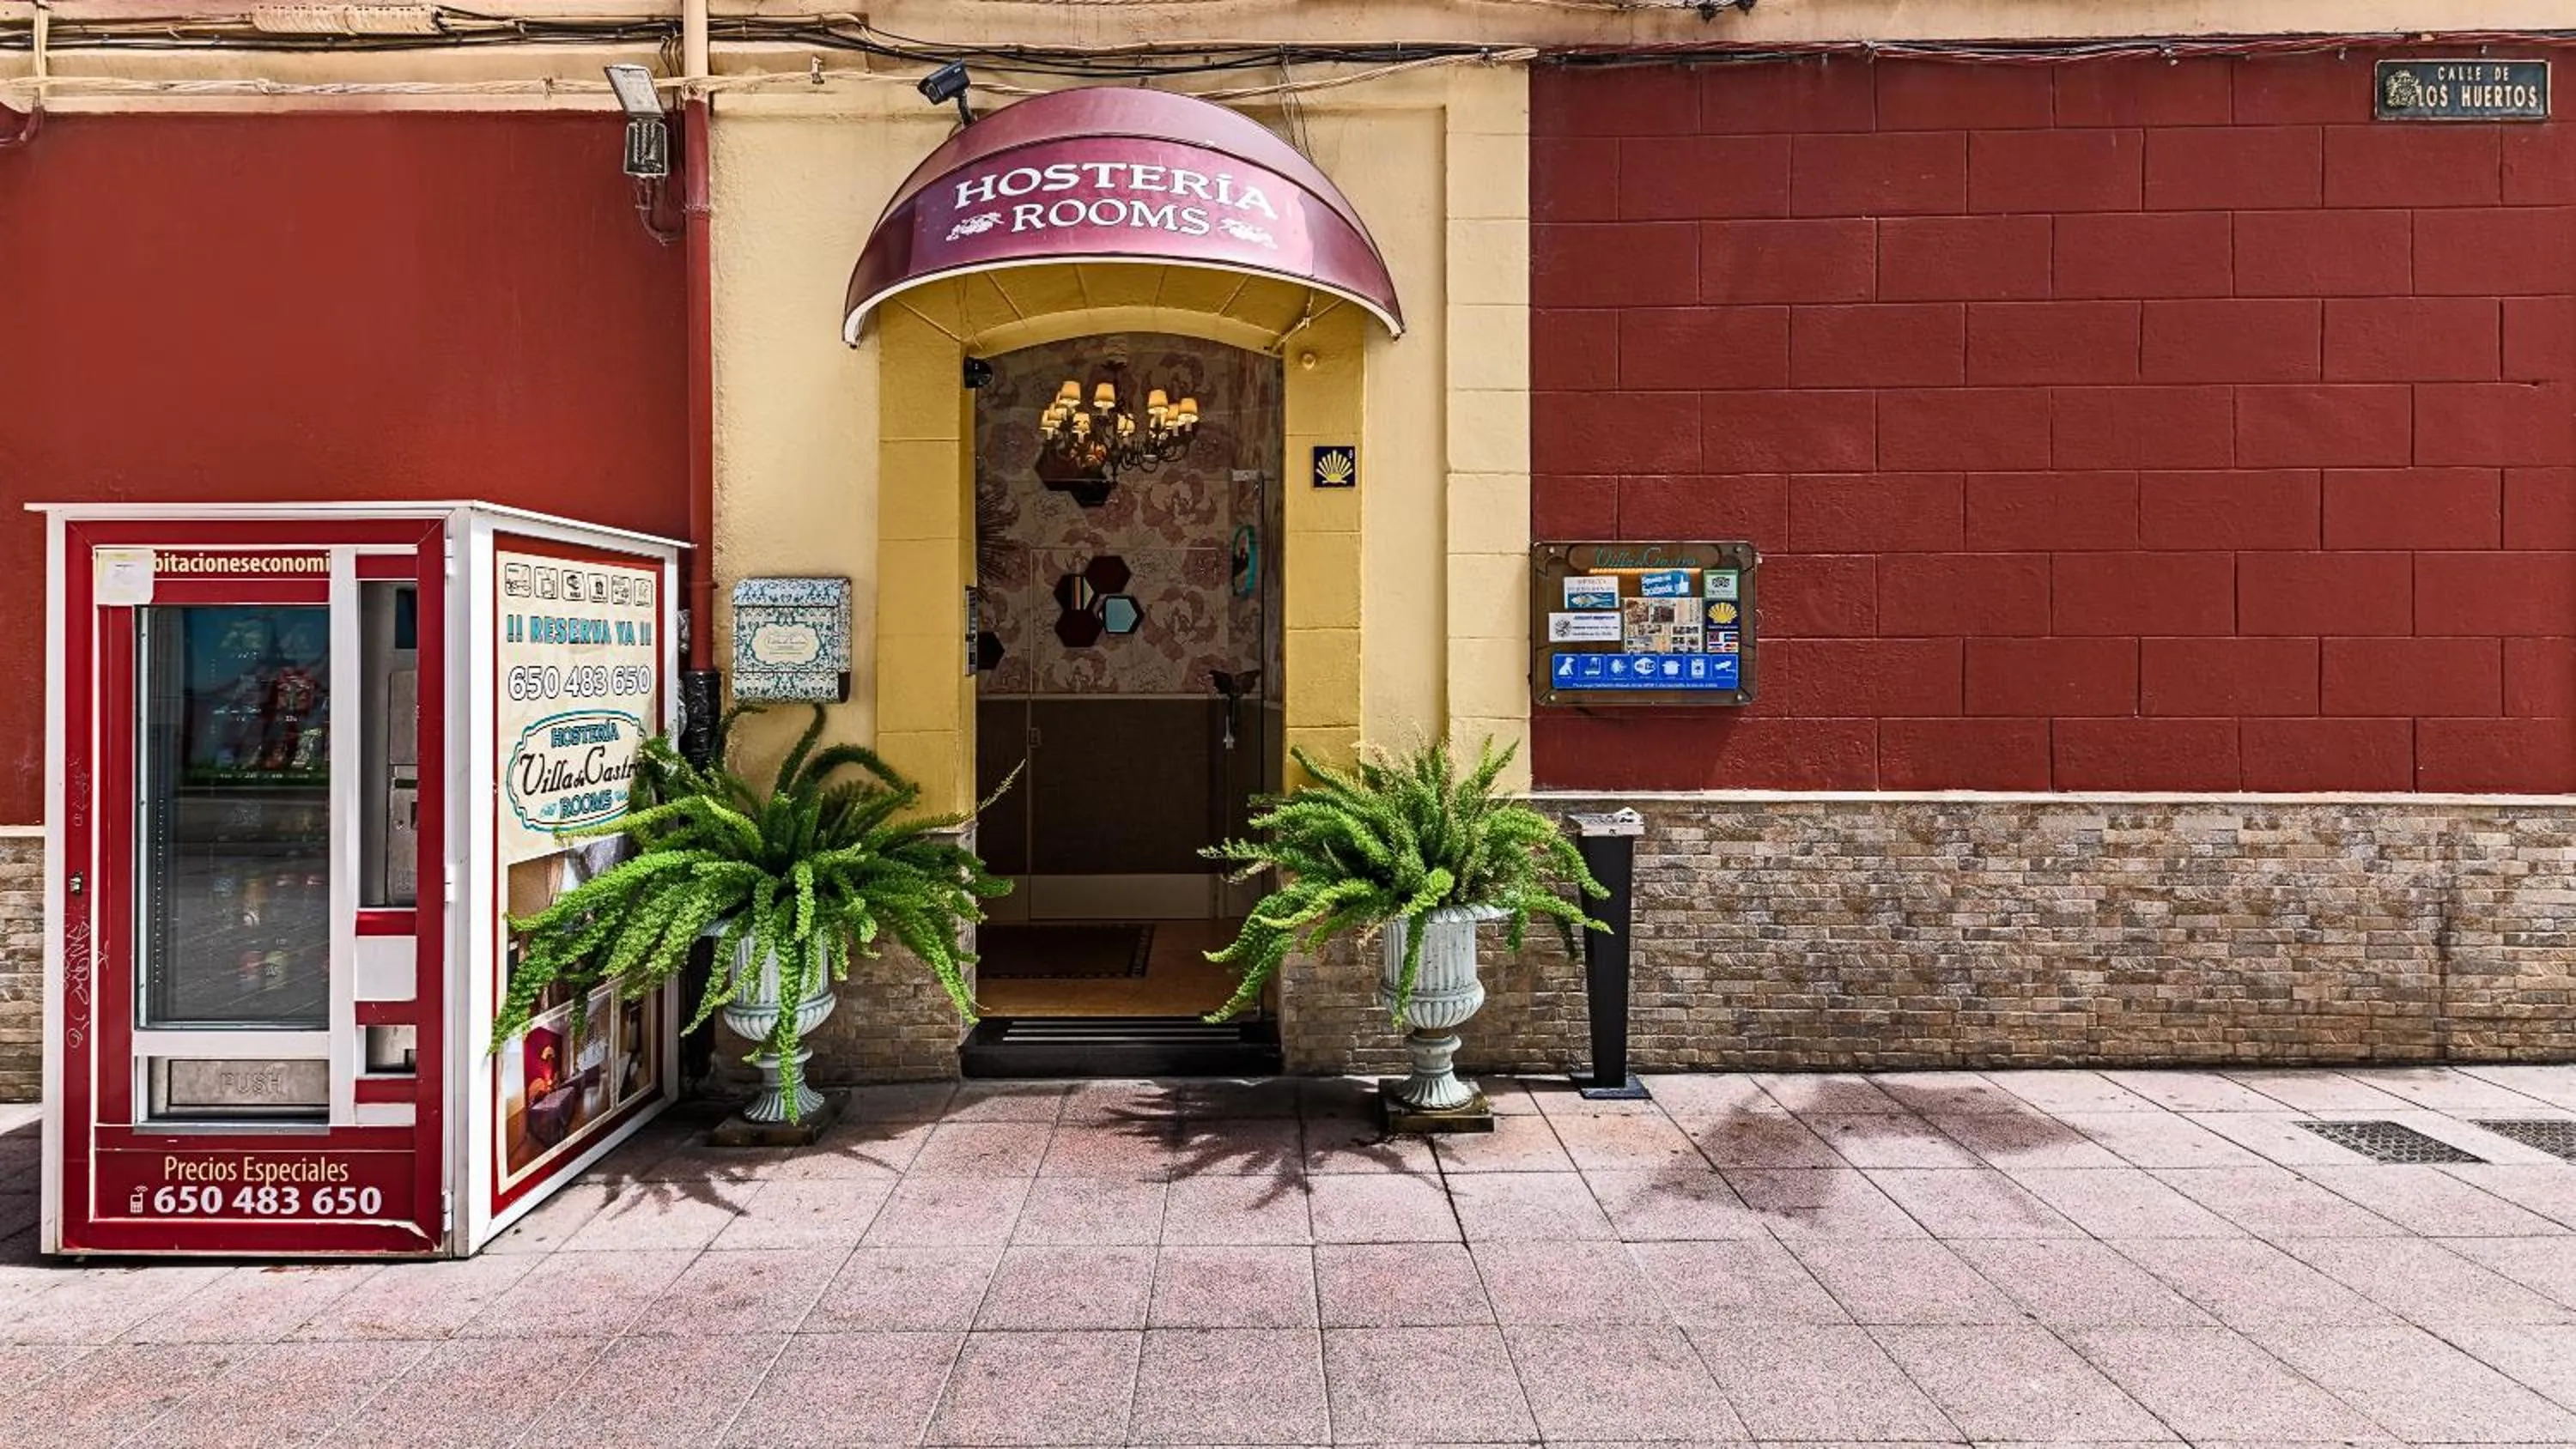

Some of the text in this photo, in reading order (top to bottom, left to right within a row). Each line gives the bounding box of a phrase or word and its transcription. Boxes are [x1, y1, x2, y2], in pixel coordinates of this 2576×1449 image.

[2437, 65, 2509, 82] CALLE DE
[2416, 84, 2538, 108] LOS HUERTOS
[954, 161, 1279, 221] HOSTERÍA
[1010, 197, 1211, 236] ROOMS
[530, 615, 612, 645] RESERVA
[615, 621, 636, 646] YA
[508, 664, 652, 701] 650 483 650
[519, 753, 573, 797] Villa
[585, 745, 644, 785] Castr
[559, 789, 613, 820] ROOMS
[220, 1072, 283, 1094] PUSH
[164, 1155, 349, 1188] Precios Especiales
[153, 1185, 383, 1216] 650 483 650
